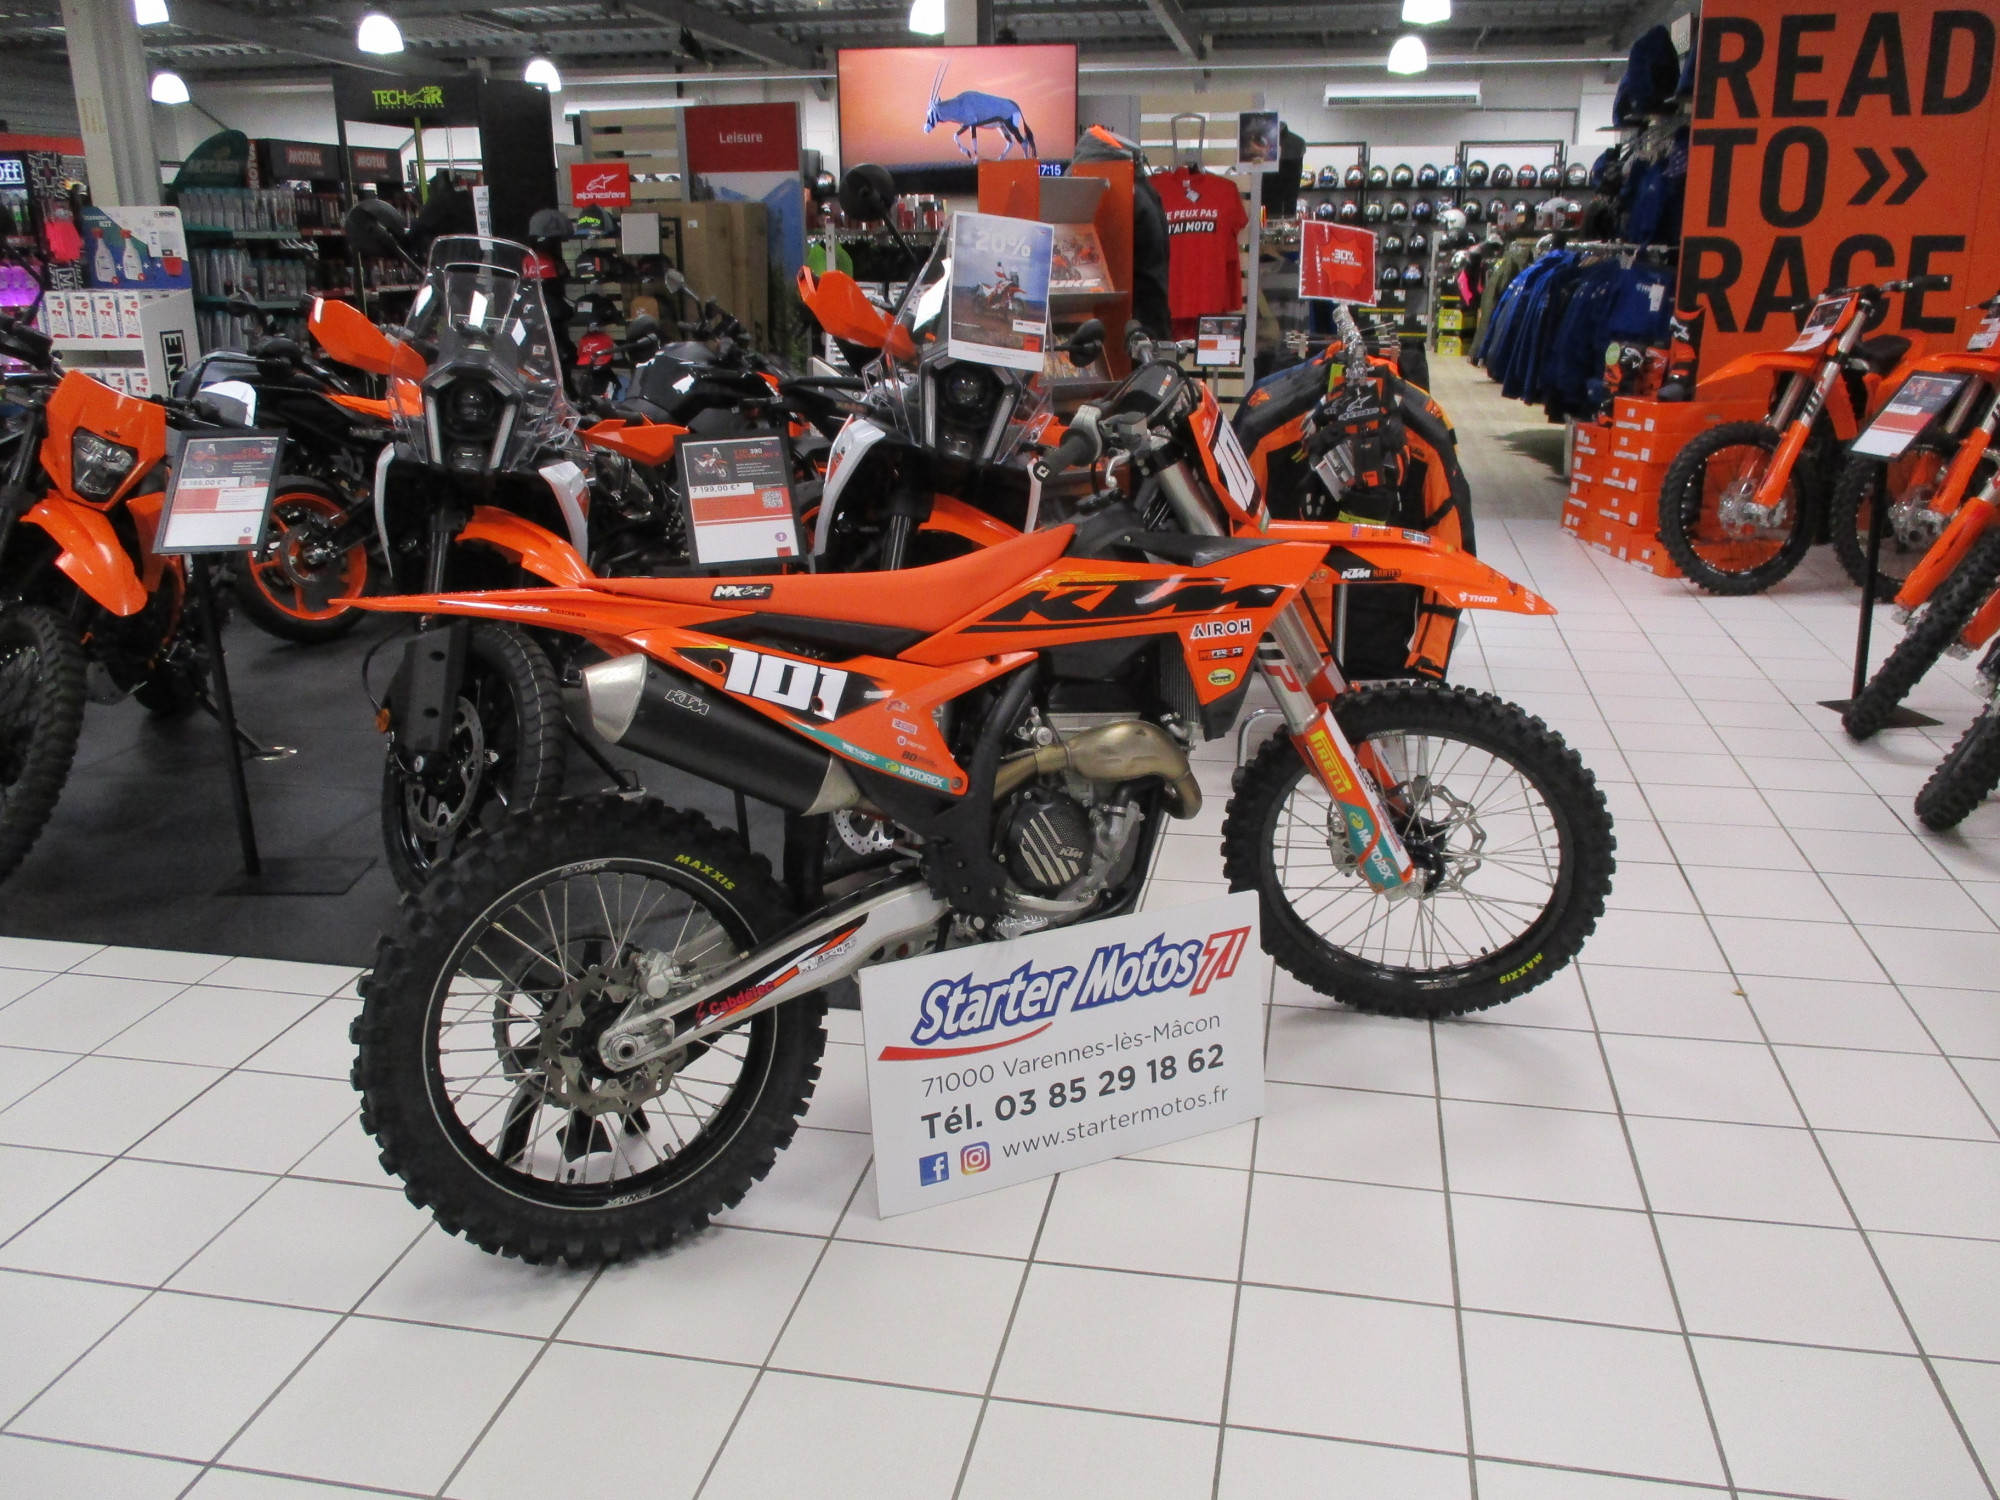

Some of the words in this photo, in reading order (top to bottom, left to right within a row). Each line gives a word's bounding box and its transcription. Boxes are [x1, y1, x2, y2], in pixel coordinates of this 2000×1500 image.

[719, 131, 763, 144] Leisure
[1692, 126, 1829, 229] TO
[576, 191, 626, 200] alpinestars
[1166, 211, 1172, 221] E
[1173, 209, 1198, 219] PEUX
[1200, 208, 1217, 218] PAS
[1185, 221, 1214, 232] MOTO
[1676, 234, 1966, 334] RACE
[1341, 568, 1371, 579] KTM
[713, 585, 745, 598] MX
[1468, 594, 1498, 603] THOR
[1189, 618, 1253, 640] AIROH
[724, 646, 849, 721] 101
[665, 689, 710, 716] KTM
[1309, 729, 1353, 795] PIRELLI
[900, 765, 944, 788] MOTOREX
[1060, 846, 1083, 859] KTM
[674, 853, 737, 891] MAXXIS
[1499, 952, 1544, 984] MAXXIS
[910, 958, 1077, 1046] Starter
[1070, 931, 1205, 1013] Motos
[921, 1063, 995, 1098] 71000
[1002, 1013, 1221, 1079] Varennes-lès-Mâcon
[920, 1104, 983, 1139] Tél.
[994, 1088, 1037, 1122] 03
[1048, 1075, 1087, 1110] 85
[1098, 1064, 1136, 1097] 29
[1146, 1053, 1177, 1084] 18
[1187, 1042, 1225, 1073] 62
[1002, 1084, 1229, 1159] www.startermotos.fr
